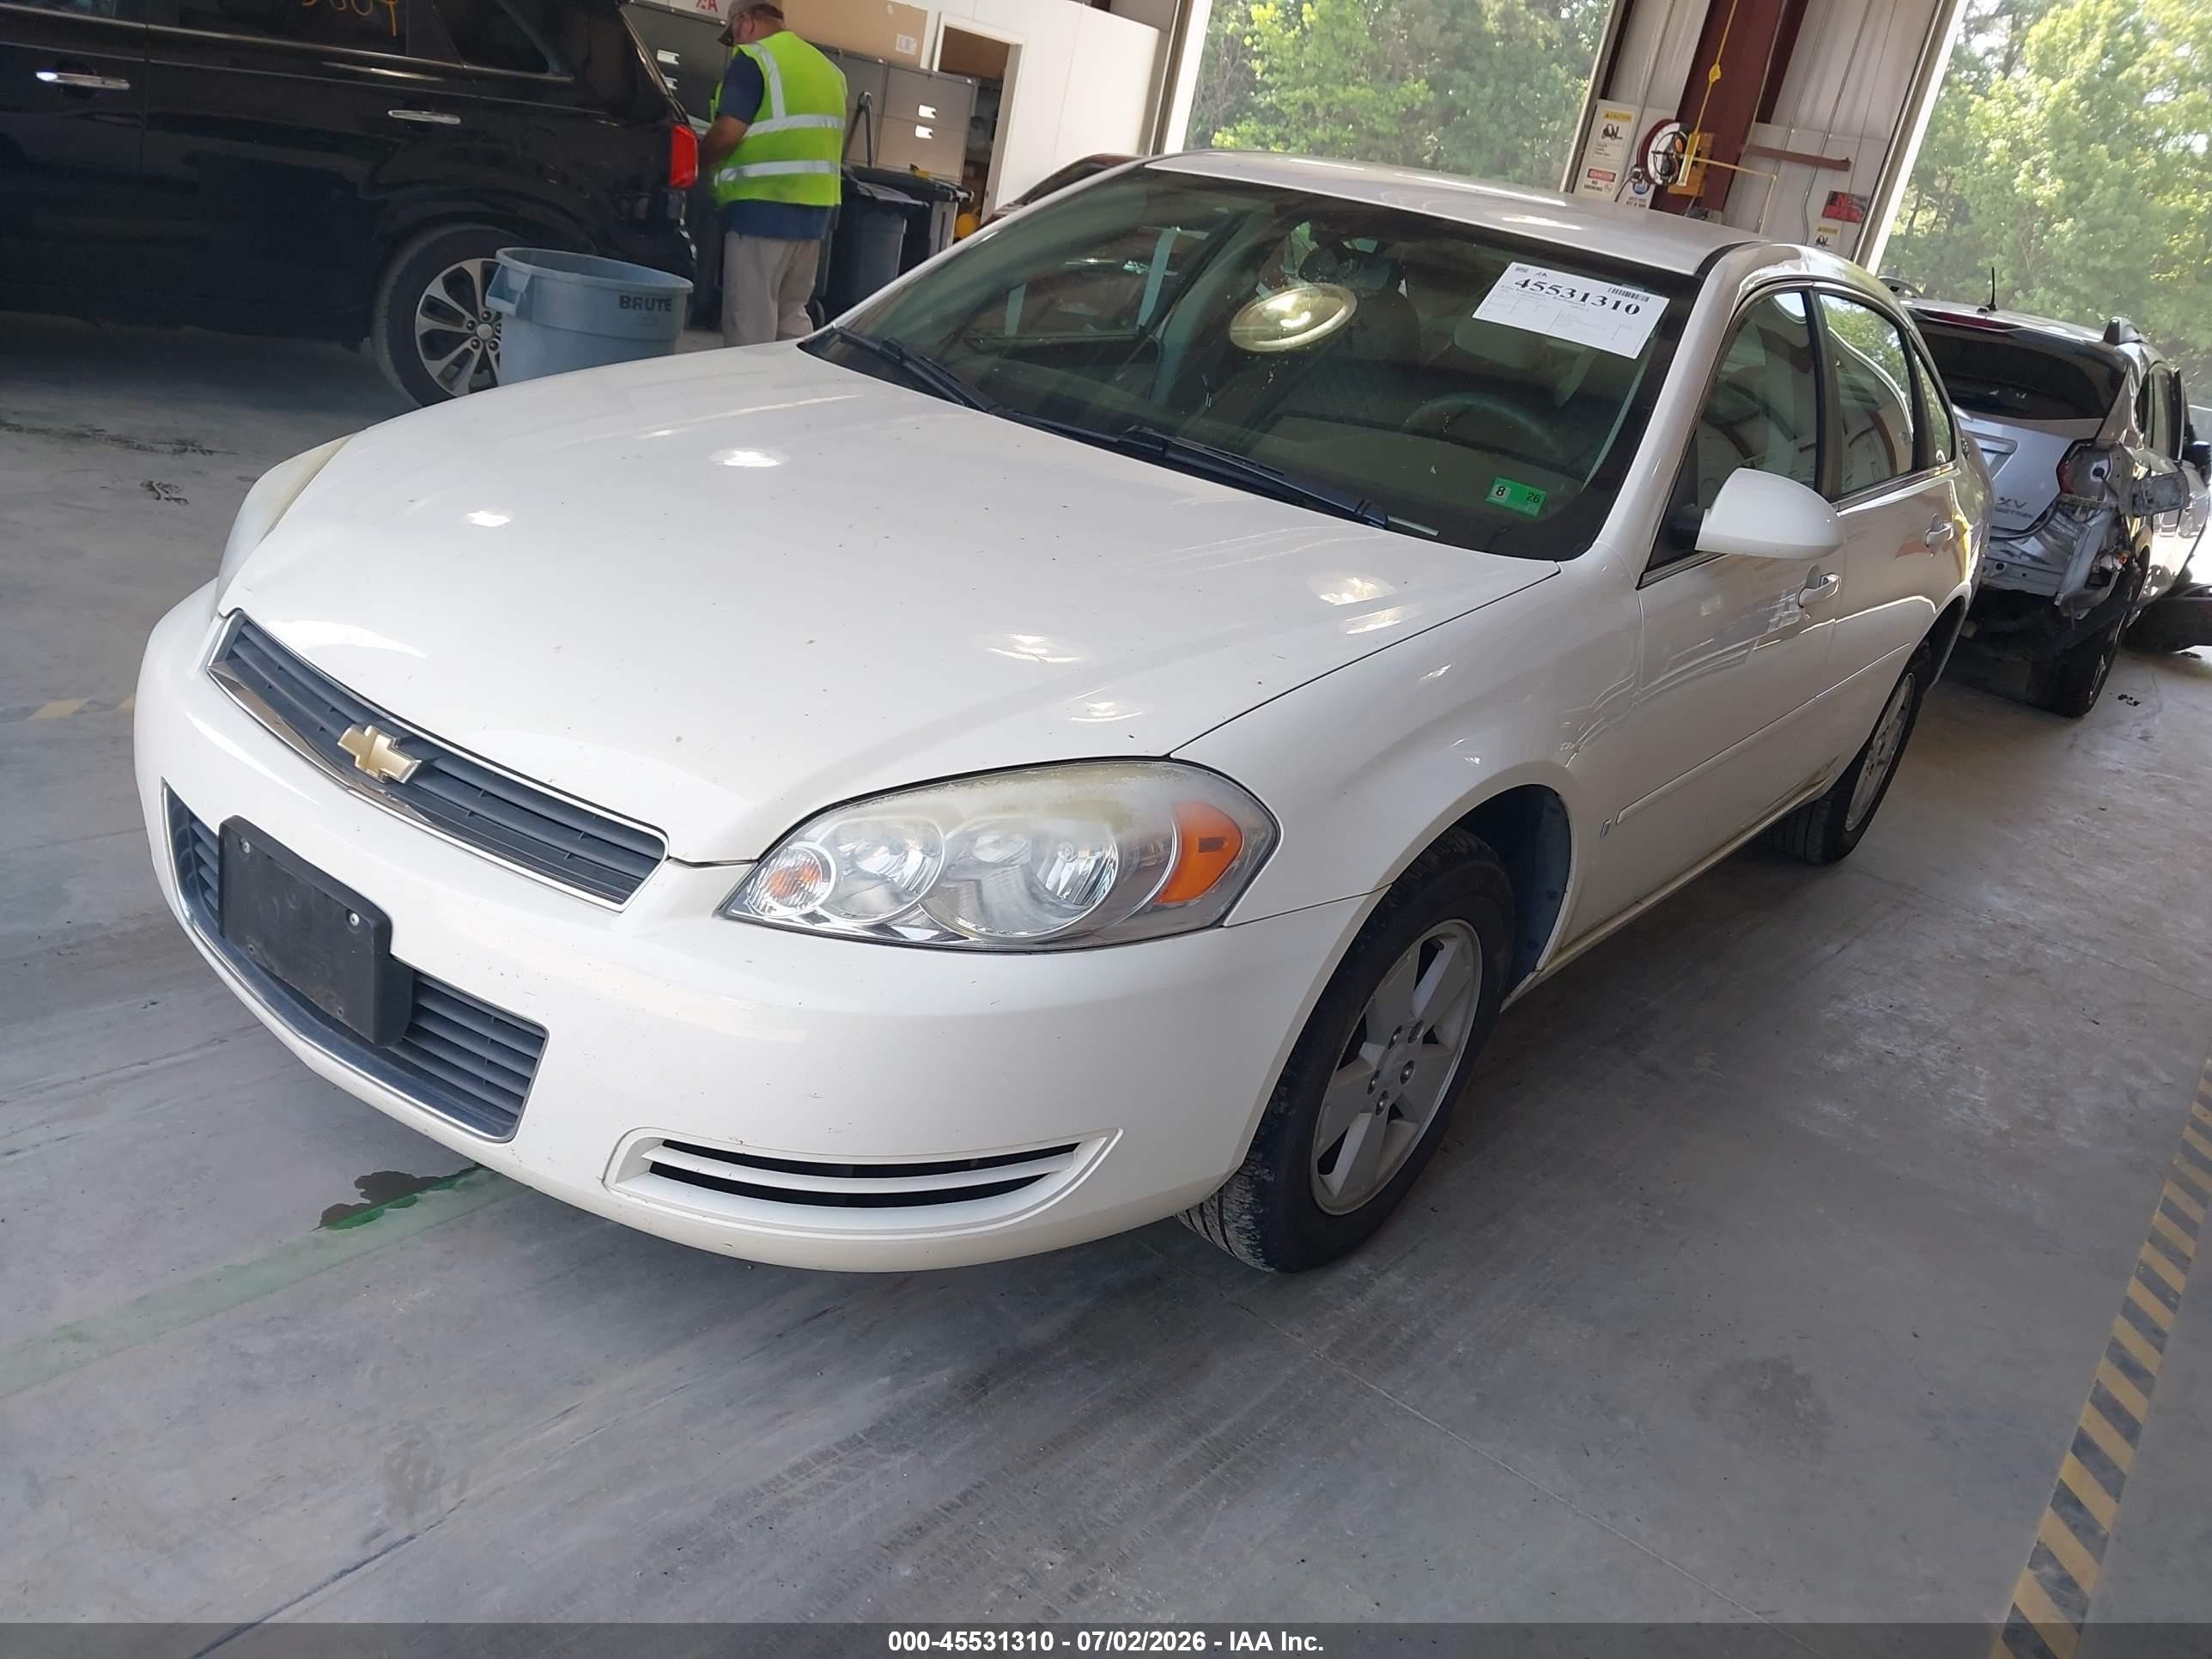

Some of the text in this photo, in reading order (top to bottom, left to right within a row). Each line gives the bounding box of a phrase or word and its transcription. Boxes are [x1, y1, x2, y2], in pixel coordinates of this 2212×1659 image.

[619, 295, 672, 312] BRUTE
[1515, 278, 1641, 314] 45531310
[1496, 486, 1540, 503] 8 26
[1997, 497, 2027, 508] XV
